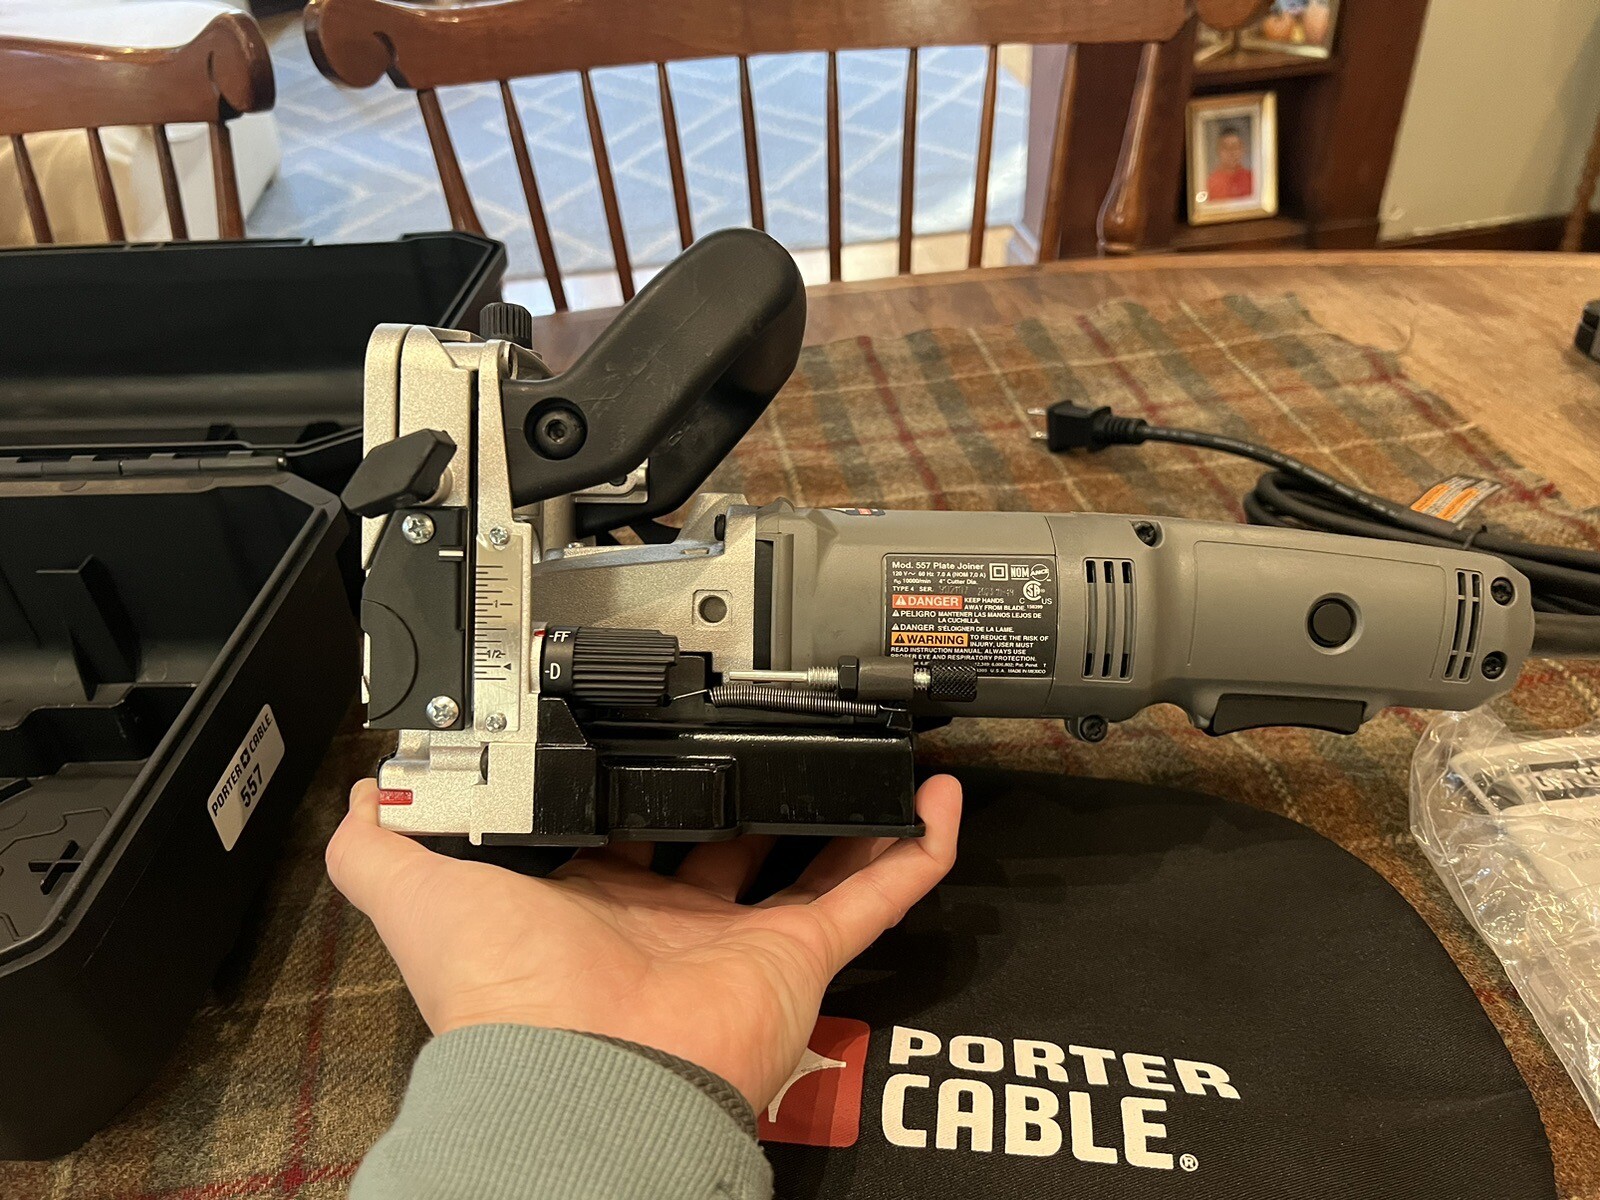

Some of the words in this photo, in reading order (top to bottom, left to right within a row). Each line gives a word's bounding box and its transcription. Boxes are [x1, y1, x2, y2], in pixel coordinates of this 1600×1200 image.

[1010, 566, 1029, 578] NOM
[493, 600, 498, 608] 1
[908, 596, 959, 606] DANGER
[907, 635, 964, 645] WARNING
[487, 650, 501, 659] 1/2
[211, 764, 243, 817] PORTER
[249, 713, 271, 753] CABLE
[240, 763, 263, 808] 557
[889, 1025, 1241, 1100] PORTER
[882, 1073, 1174, 1170] CABLE
